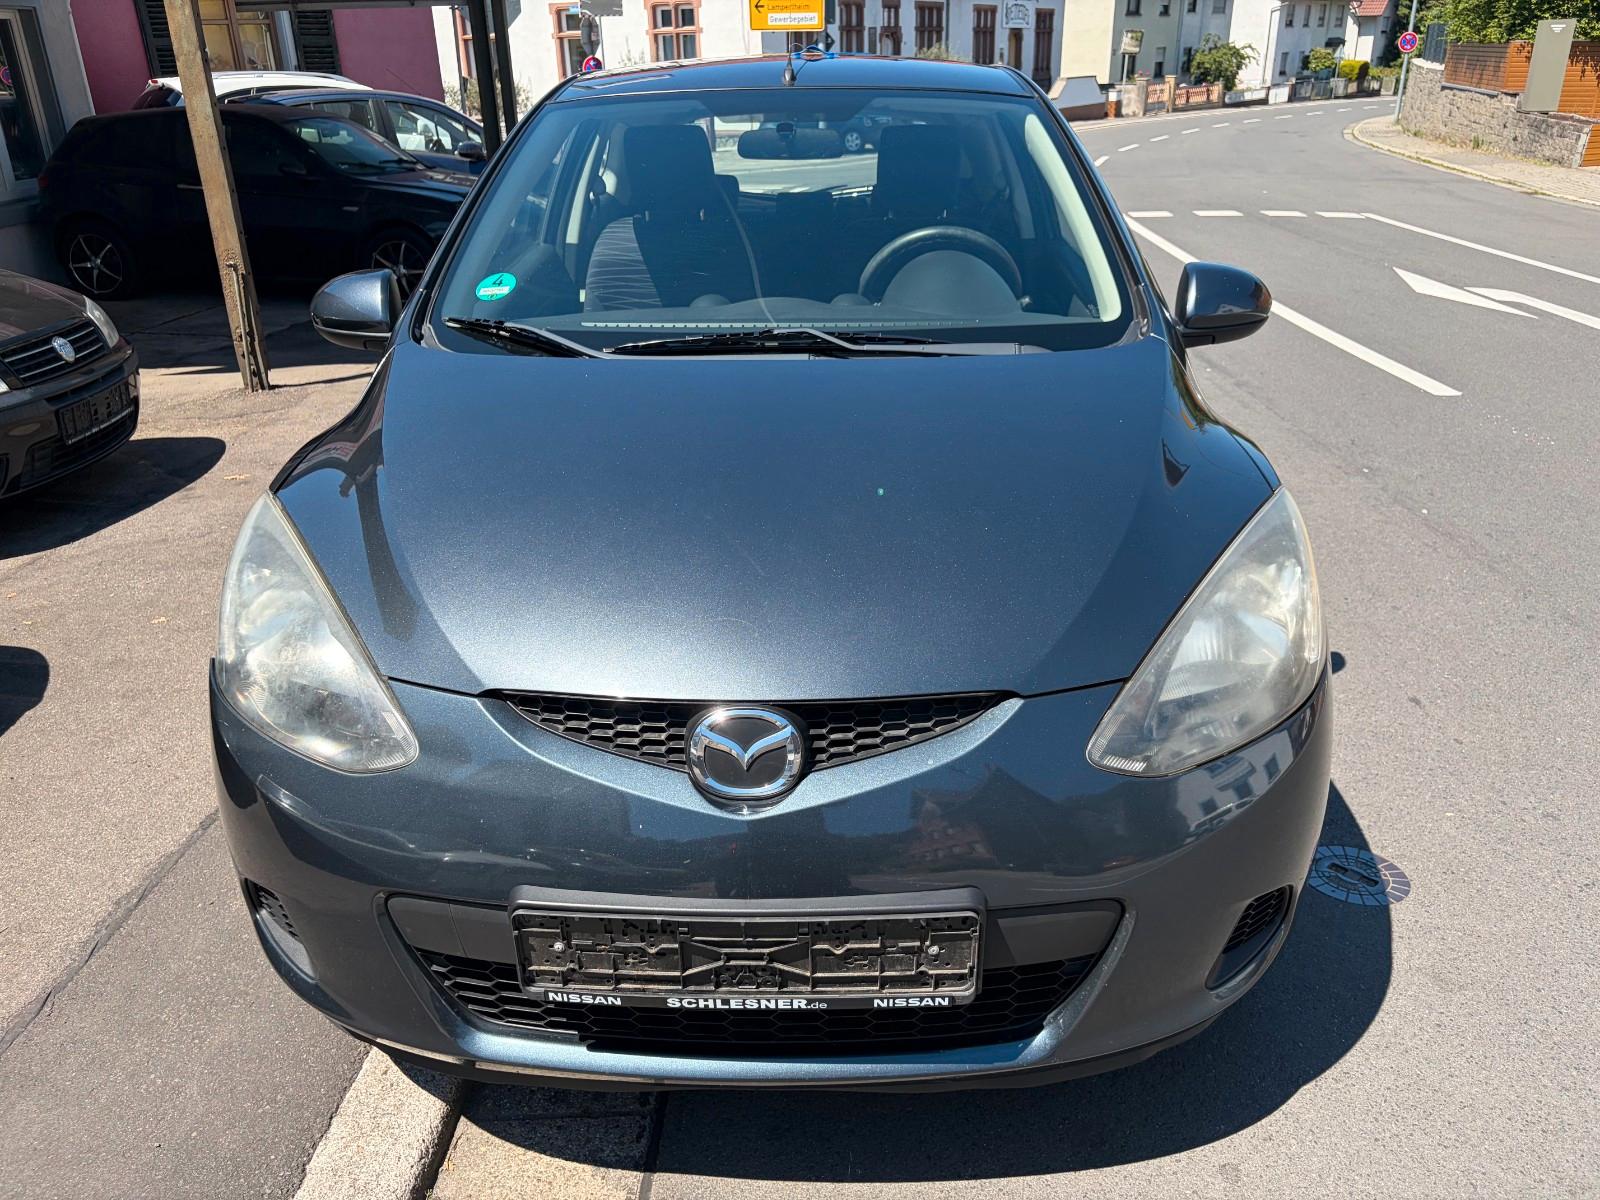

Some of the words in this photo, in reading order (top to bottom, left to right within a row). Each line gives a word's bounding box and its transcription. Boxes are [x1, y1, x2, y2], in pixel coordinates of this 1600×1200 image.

[769, 15, 816, 24] Gewerbegebiet
[491, 273, 505, 287] 4
[548, 992, 622, 1005] NISSAN
[666, 998, 828, 1009] SCHLESNER.de
[873, 997, 949, 1008] NISSAN
